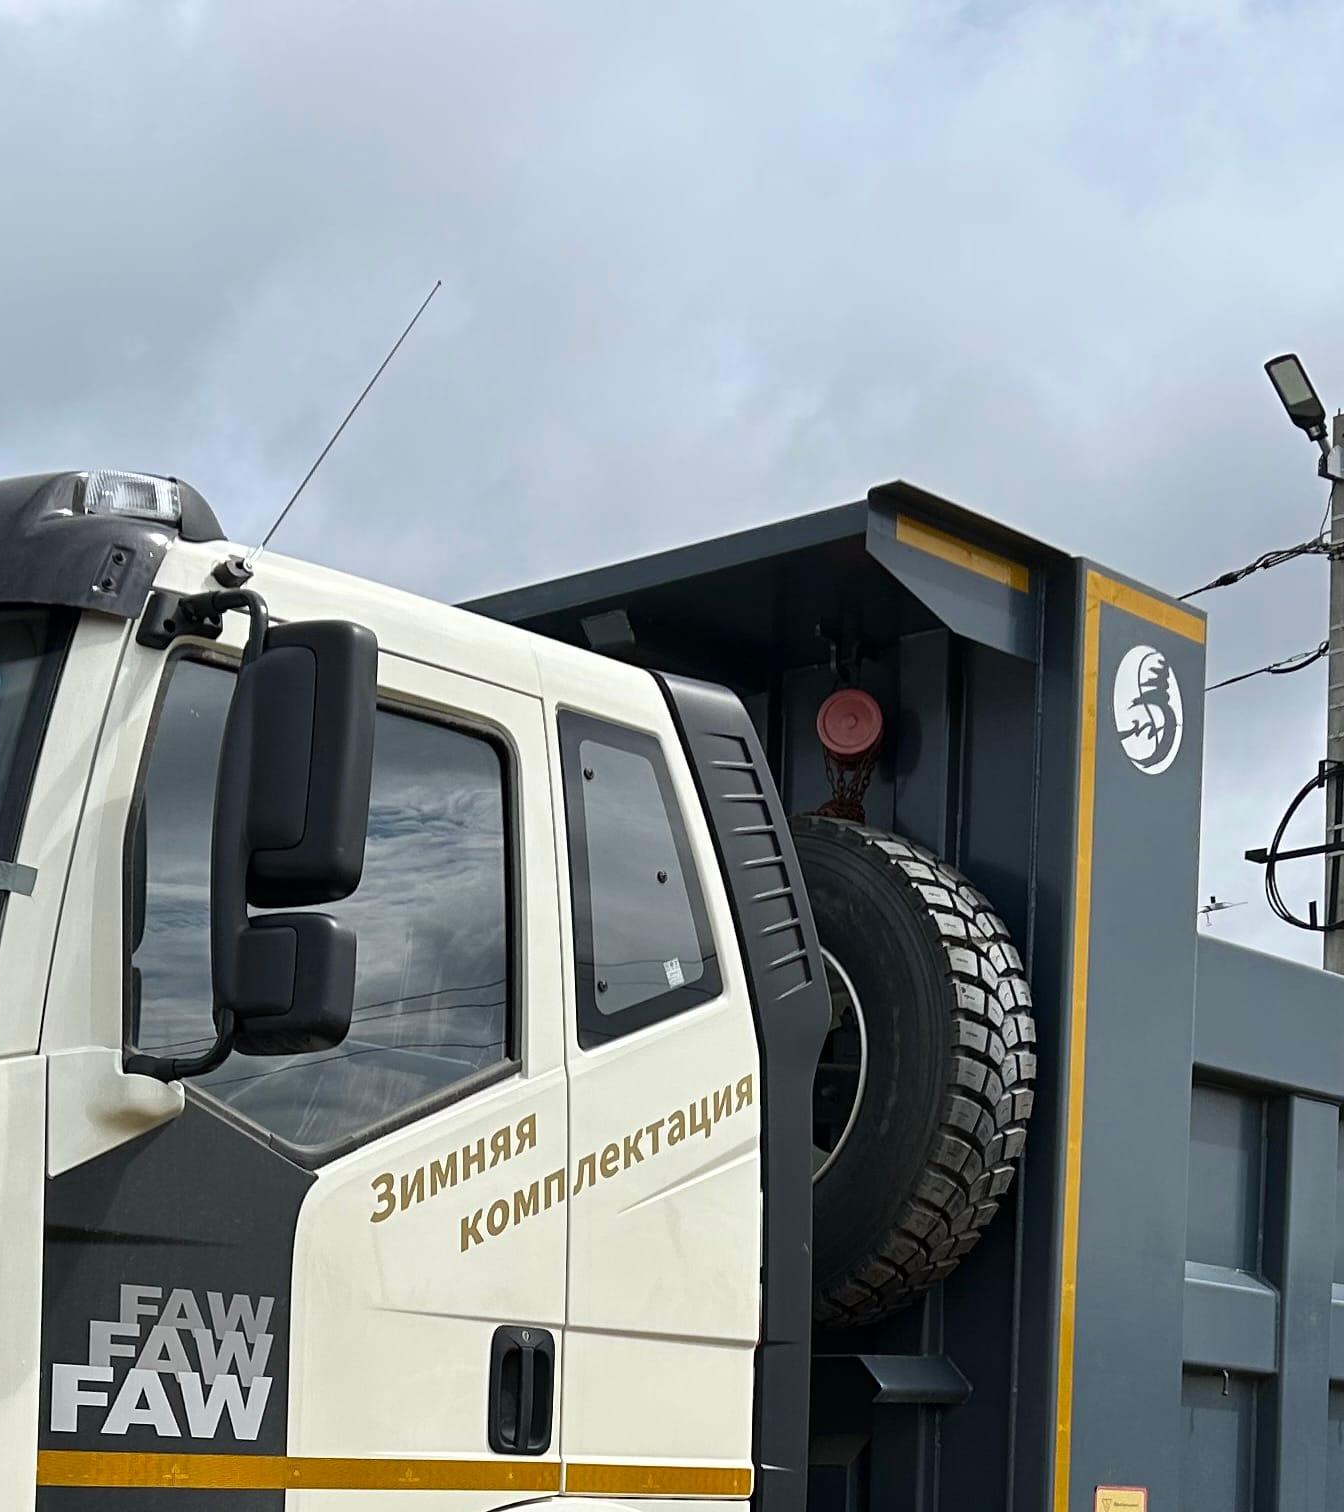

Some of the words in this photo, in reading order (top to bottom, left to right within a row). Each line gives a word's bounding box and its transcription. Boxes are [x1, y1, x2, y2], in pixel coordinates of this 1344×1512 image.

[369, 1112, 537, 1224] Зимняя
[460, 1073, 753, 1253] комплектация
[119, 1283, 275, 1344] FAW
[88, 1319, 274, 1388] FAW
[50, 1362, 273, 1441] FAW
